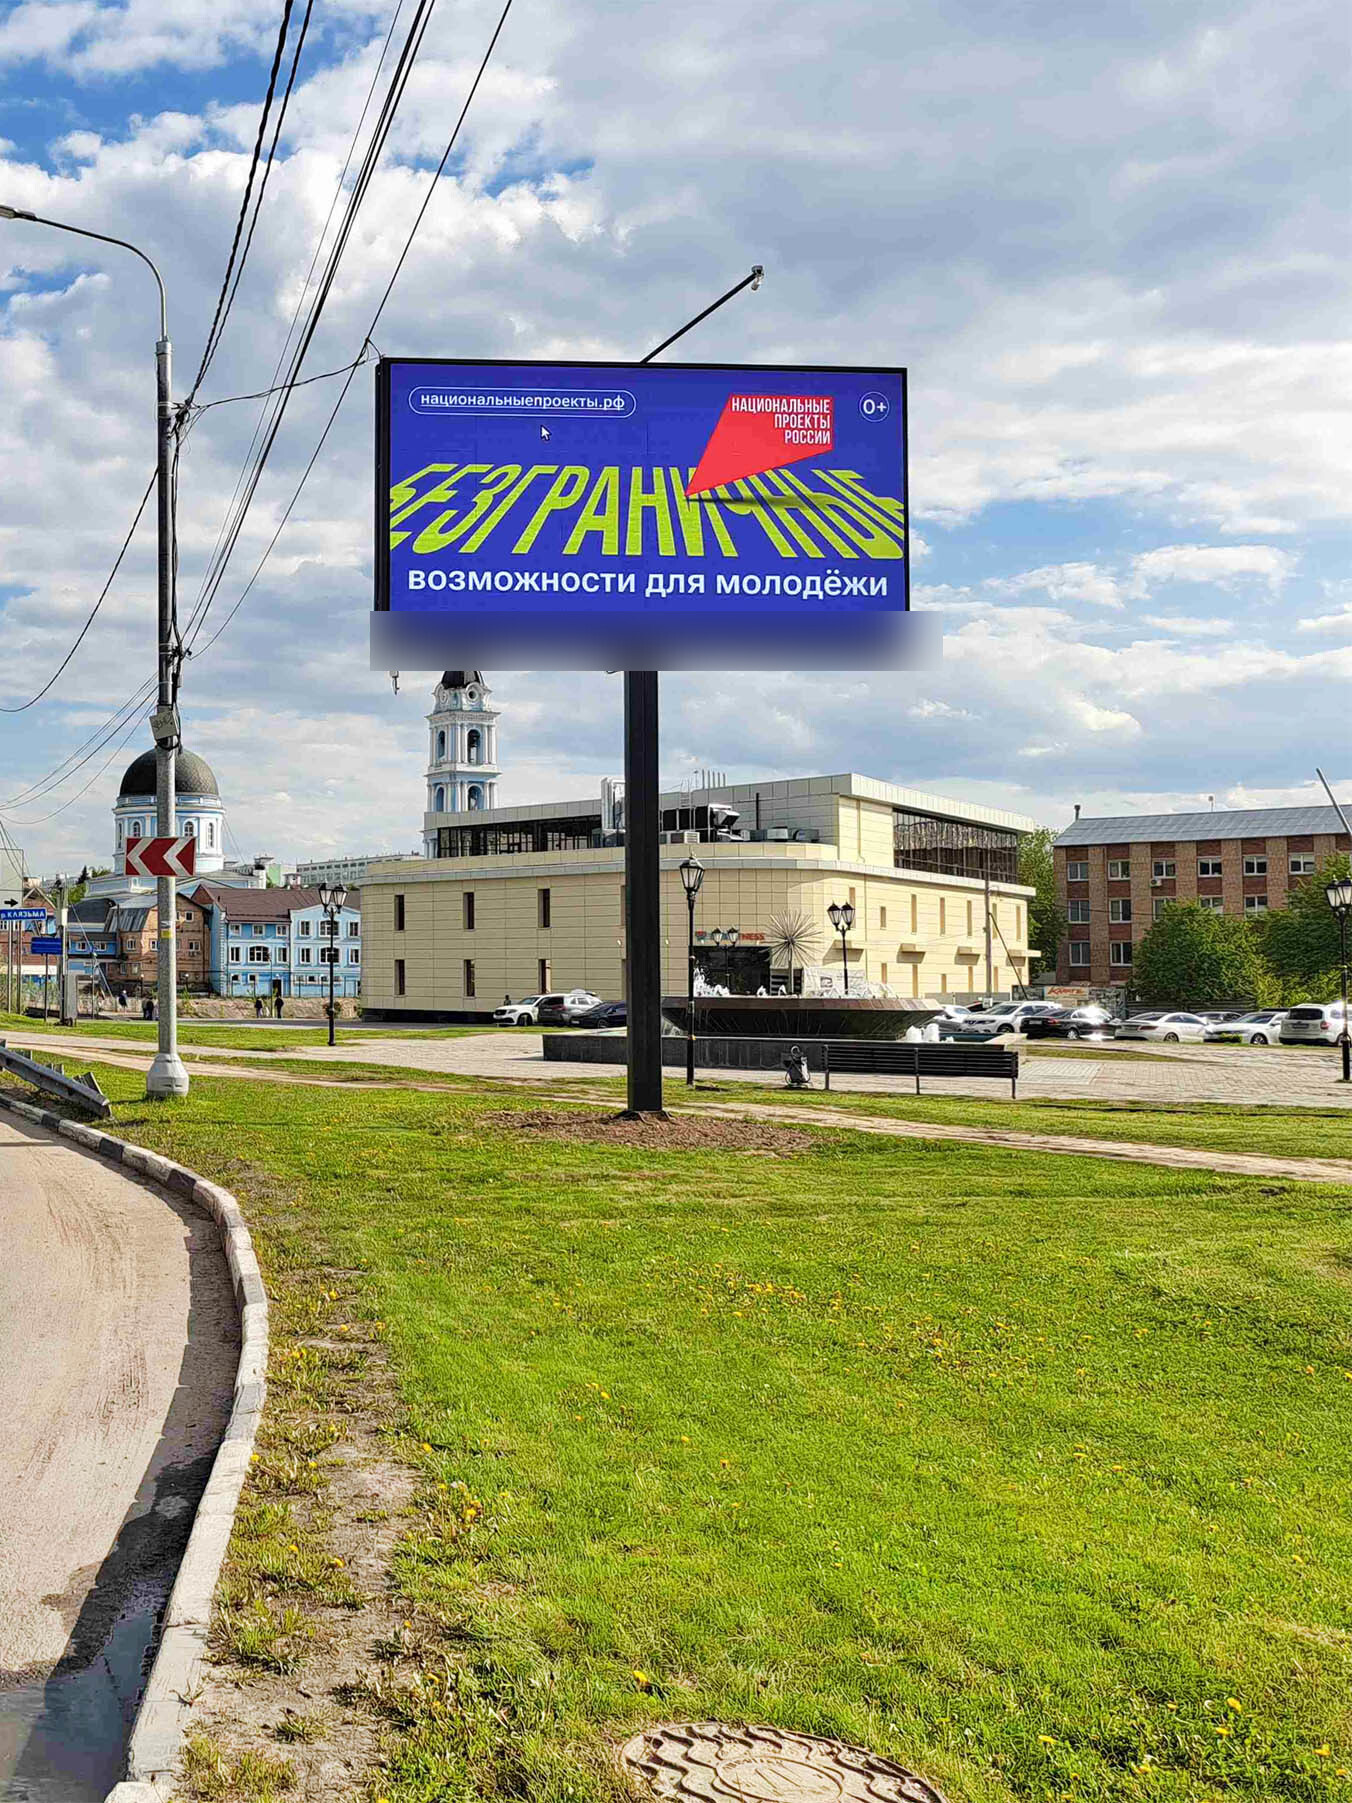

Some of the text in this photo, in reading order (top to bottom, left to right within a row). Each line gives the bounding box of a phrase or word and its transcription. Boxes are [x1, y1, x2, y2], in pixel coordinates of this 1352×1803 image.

[421, 393, 625, 411] национальныепроекты.рф
[731, 397, 830, 413] НАЦИОНАЛЬНЫЕ
[862, 399, 887, 414] 0+
[774, 414, 831, 429] ПРОЕКТЫ
[784, 430, 831, 445] РОССИИ
[408, 569, 888, 600] возможности для молодёжи
